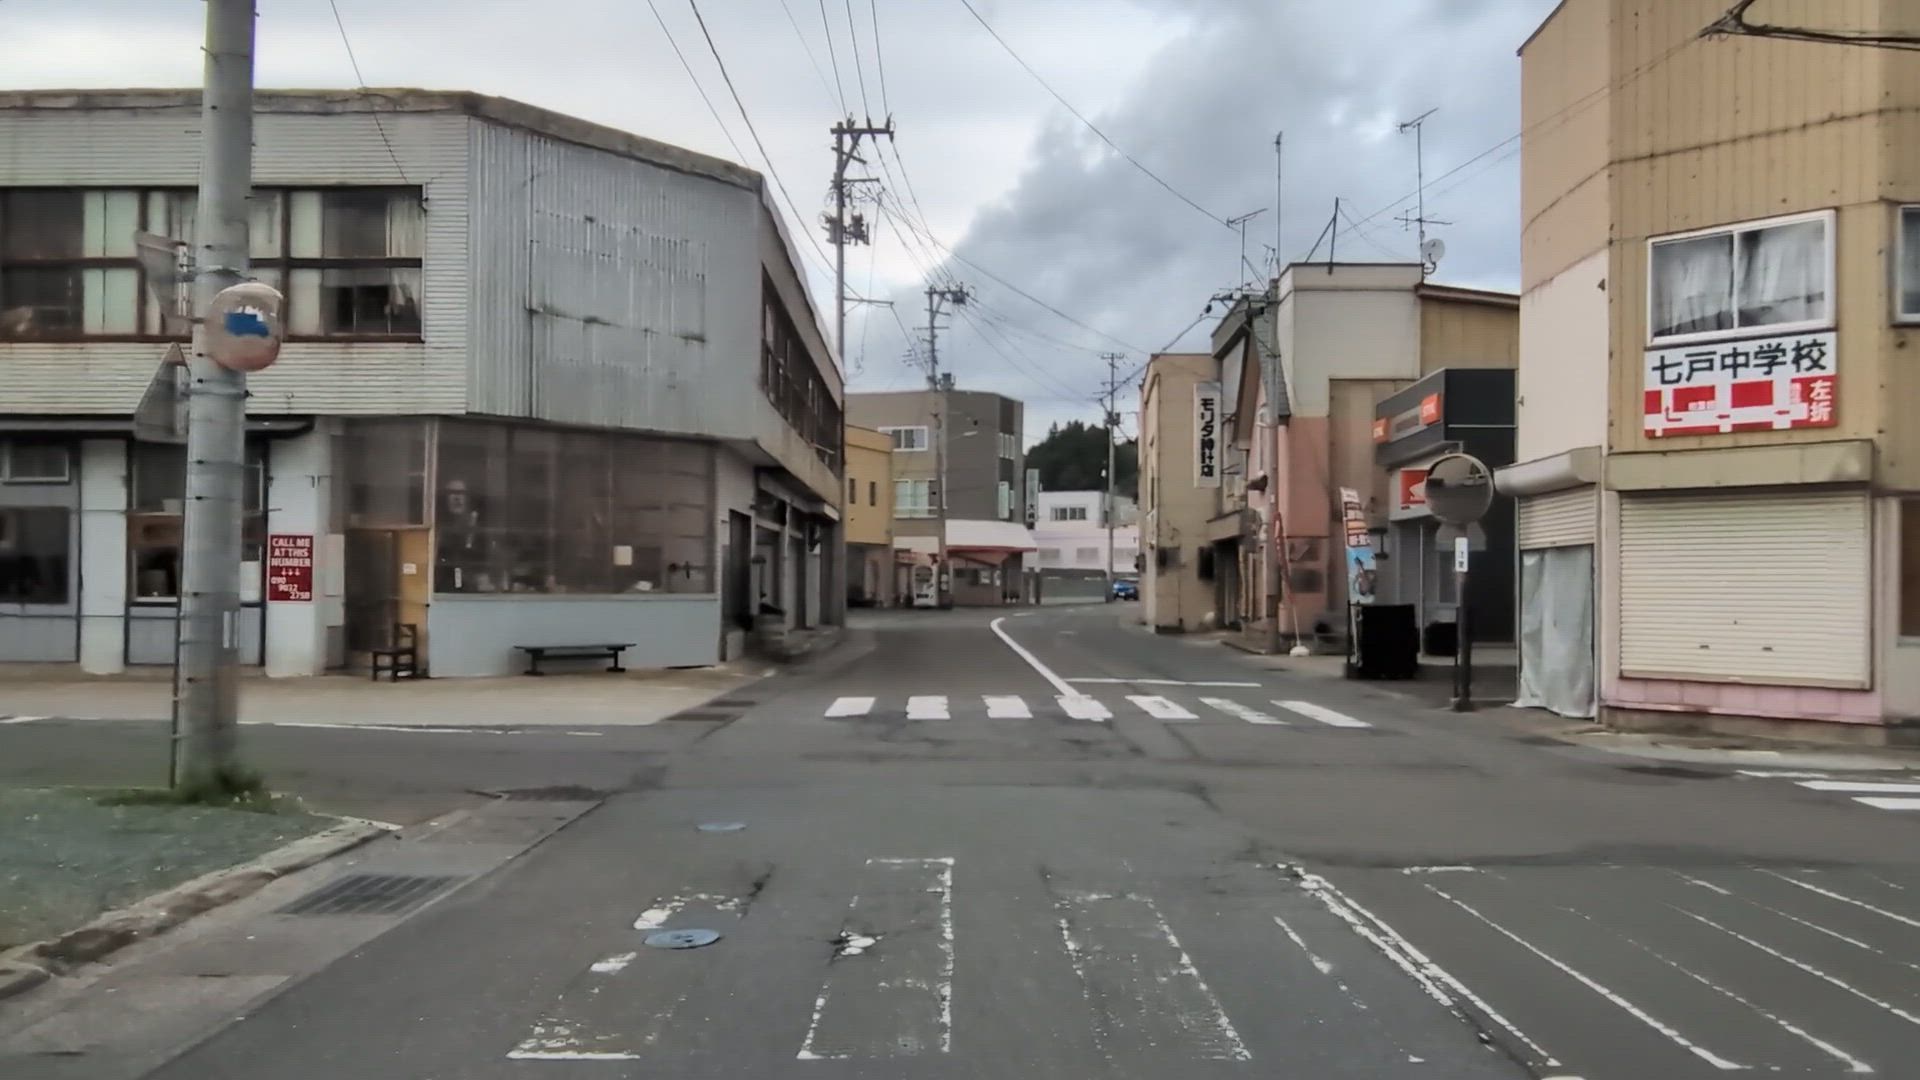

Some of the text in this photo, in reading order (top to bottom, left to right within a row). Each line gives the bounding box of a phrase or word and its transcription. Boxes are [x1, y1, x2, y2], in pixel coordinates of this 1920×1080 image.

[1652, 338, 1827, 385] 七戸中学校
[1810, 379, 1832, 422] 左折
[272, 538, 310, 547] CALL ME
[274, 548, 309, 557] AT THIS
[271, 558, 311, 567] NUMBER
